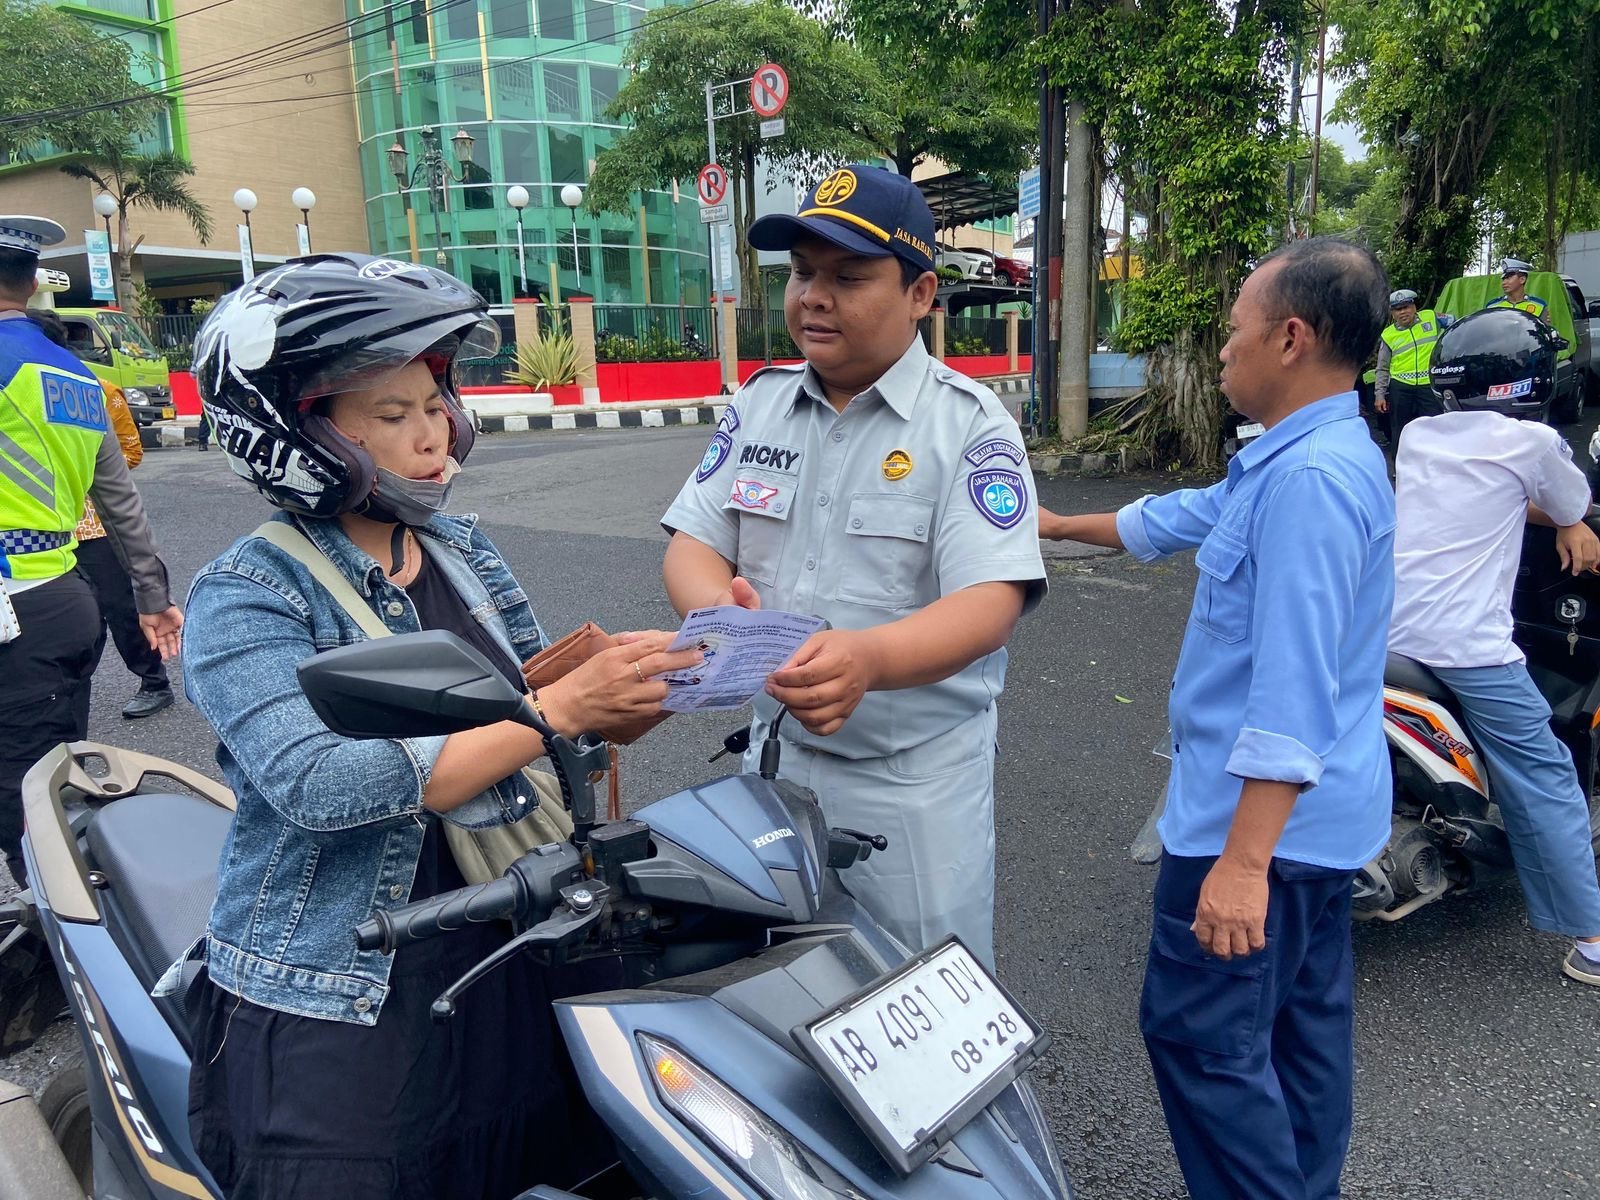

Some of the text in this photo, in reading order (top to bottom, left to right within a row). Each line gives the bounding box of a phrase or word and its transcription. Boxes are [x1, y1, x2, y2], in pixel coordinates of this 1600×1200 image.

[45, 378, 106, 426] POLISI
[739, 444, 799, 470] RICKY
[974, 474, 1019, 488] JASA RAHARJA
[752, 828, 795, 848] HONDA
[829, 956, 983, 1082] AB 4091 DV
[59, 935, 164, 1154] VARIO
